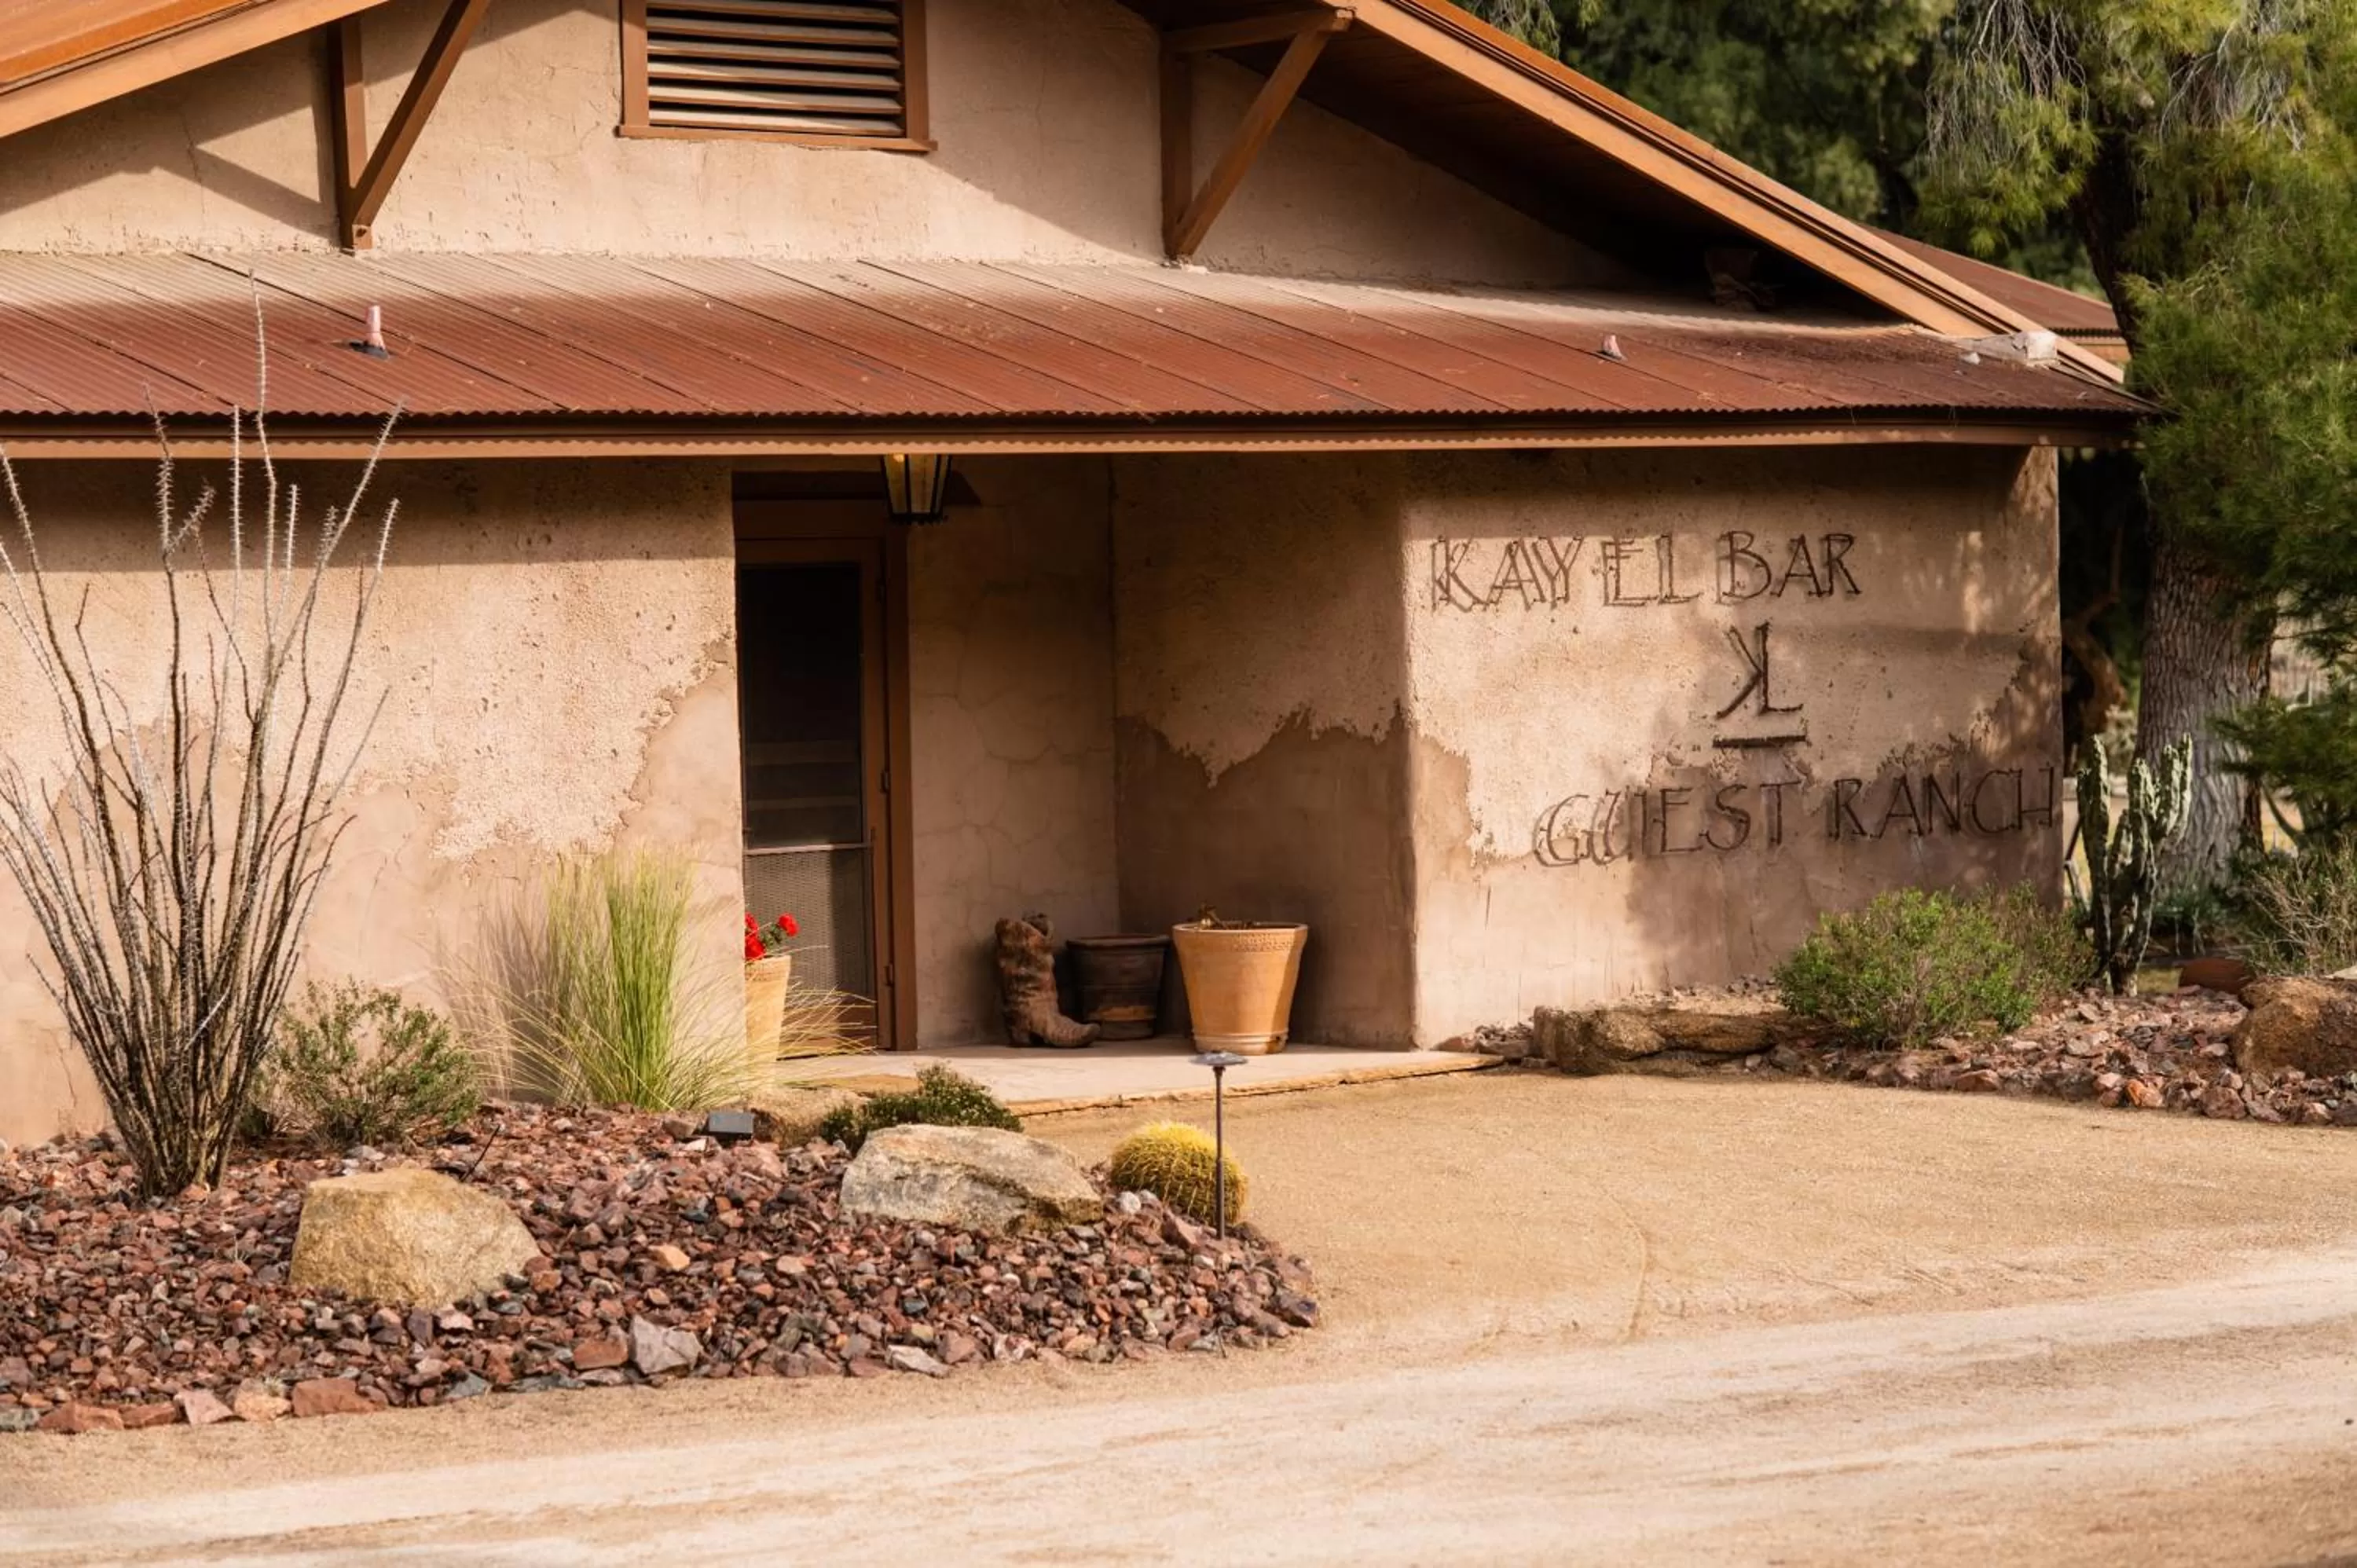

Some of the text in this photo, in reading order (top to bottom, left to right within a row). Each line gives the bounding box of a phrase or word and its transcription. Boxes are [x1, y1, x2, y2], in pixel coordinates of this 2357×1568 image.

[1435, 529, 1862, 607] KAY EL BAR
[1537, 767, 2054, 864] GUEST RANCH
